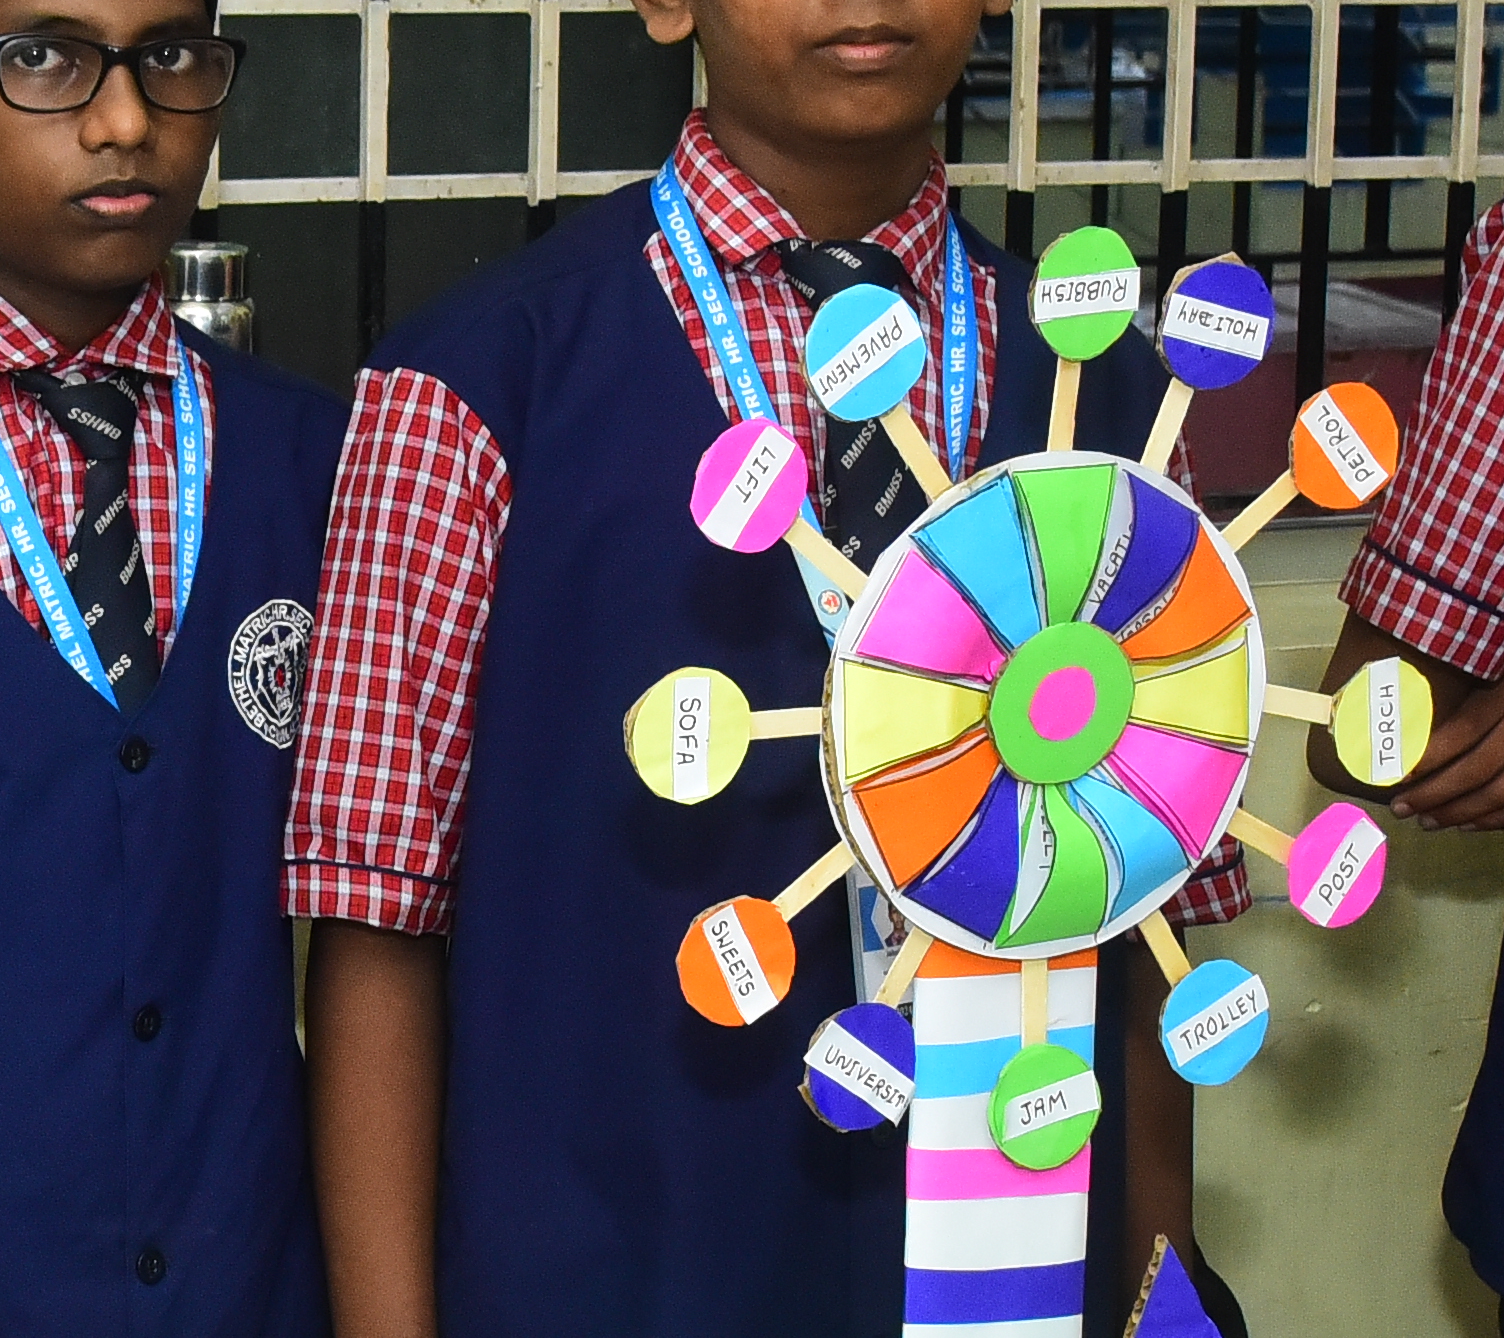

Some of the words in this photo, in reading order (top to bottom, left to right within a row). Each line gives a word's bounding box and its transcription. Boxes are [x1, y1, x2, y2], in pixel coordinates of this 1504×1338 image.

[702, 282, 729, 332] SEC.
[950, 299, 967, 337] SEC.
[1176, 297, 1258, 341] HOLIDAY
[720, 331, 744, 364] HR.
[821, 314, 904, 397] PAVEMENT
[949, 342, 966, 373] HR.
[734, 367, 764, 420] TRIC.
[67, 407, 122, 440] BMHSS
[841, 418, 877, 470] BMHSS
[1315, 403, 1374, 484] PETROL
[182, 430, 197, 476] SEC.
[738, 444, 776, 506] LIFT
[184, 483, 196, 517] HR.
[874, 467, 903, 518] BMHSS
[9, 514, 36, 552] HR.
[1089, 523, 1134, 605] VACATI
[104, 652, 132, 687] HSS
[678, 698, 701, 767] SOFA
[1377, 681, 1395, 765] TORCH
[1318, 841, 1362, 905] POST
[711, 919, 756, 998] SWEETS
[1180, 990, 1257, 1050] TROLLEY
[1021, 1090, 1068, 1124] JAM
